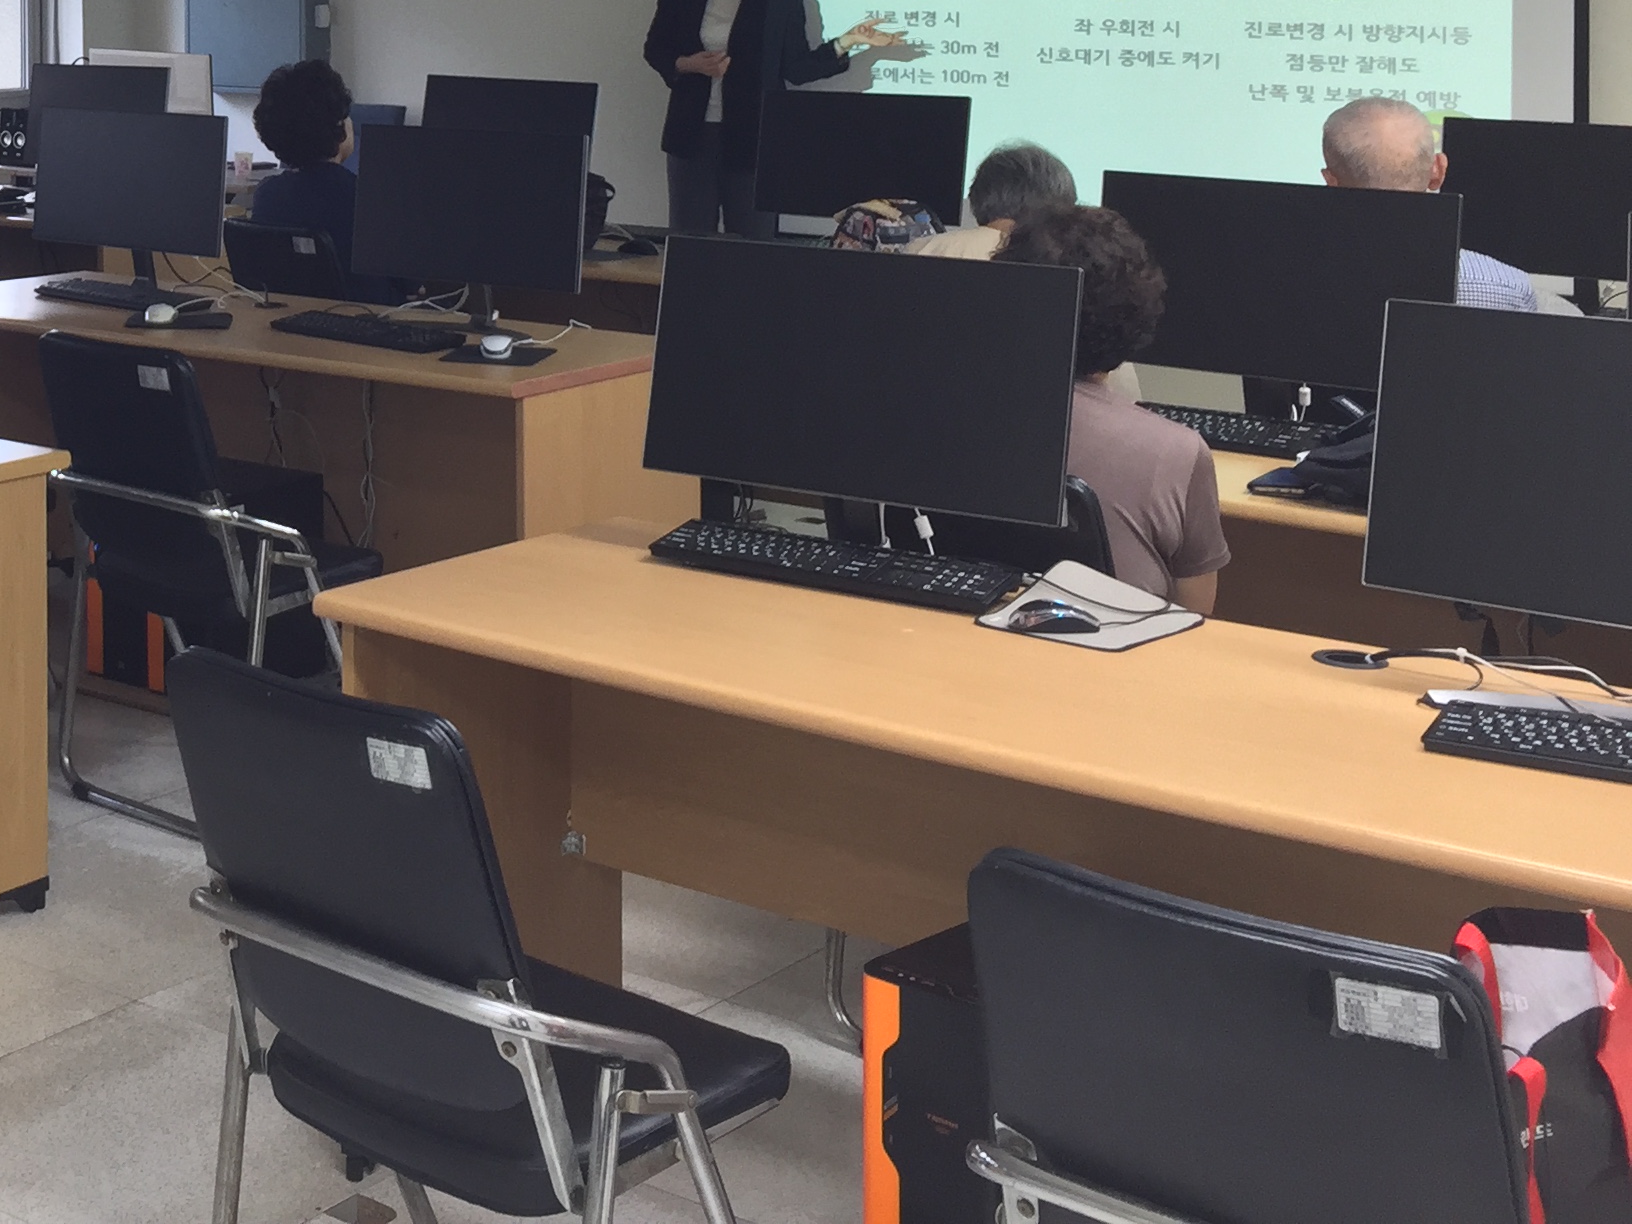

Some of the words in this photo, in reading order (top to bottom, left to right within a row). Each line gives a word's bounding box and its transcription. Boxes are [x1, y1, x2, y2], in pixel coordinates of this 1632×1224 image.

[904, 11, 937, 27] 변경
[944, 11, 960, 27] 시
[1074, 18, 1093, 35] 좌
[1099, 18, 1155, 37] 우회전
[1163, 20, 1180, 38] 시
[1244, 21, 1325, 41] 진로변경
[1334, 23, 1353, 42] 시
[1363, 24, 1472, 45] 방향지시등
[940, 40, 977, 55] 30m
[984, 41, 1000, 58] 전
[1036, 47, 1111, 66] 신호대기
[1118, 49, 1176, 67] 중에도
[1182, 51, 1220, 70] 켜기
[1286, 54, 1349, 73] 점등만
[1355, 56, 1420, 75] 잘해도
[872, 67, 934, 84] 로에서는
[942, 69, 987, 84] 100m
[994, 71, 1010, 87] 전
[1248, 84, 1289, 102] 난폭
[1296, 85, 1315, 104] 및
[1416, 90, 1461, 109] 예방
